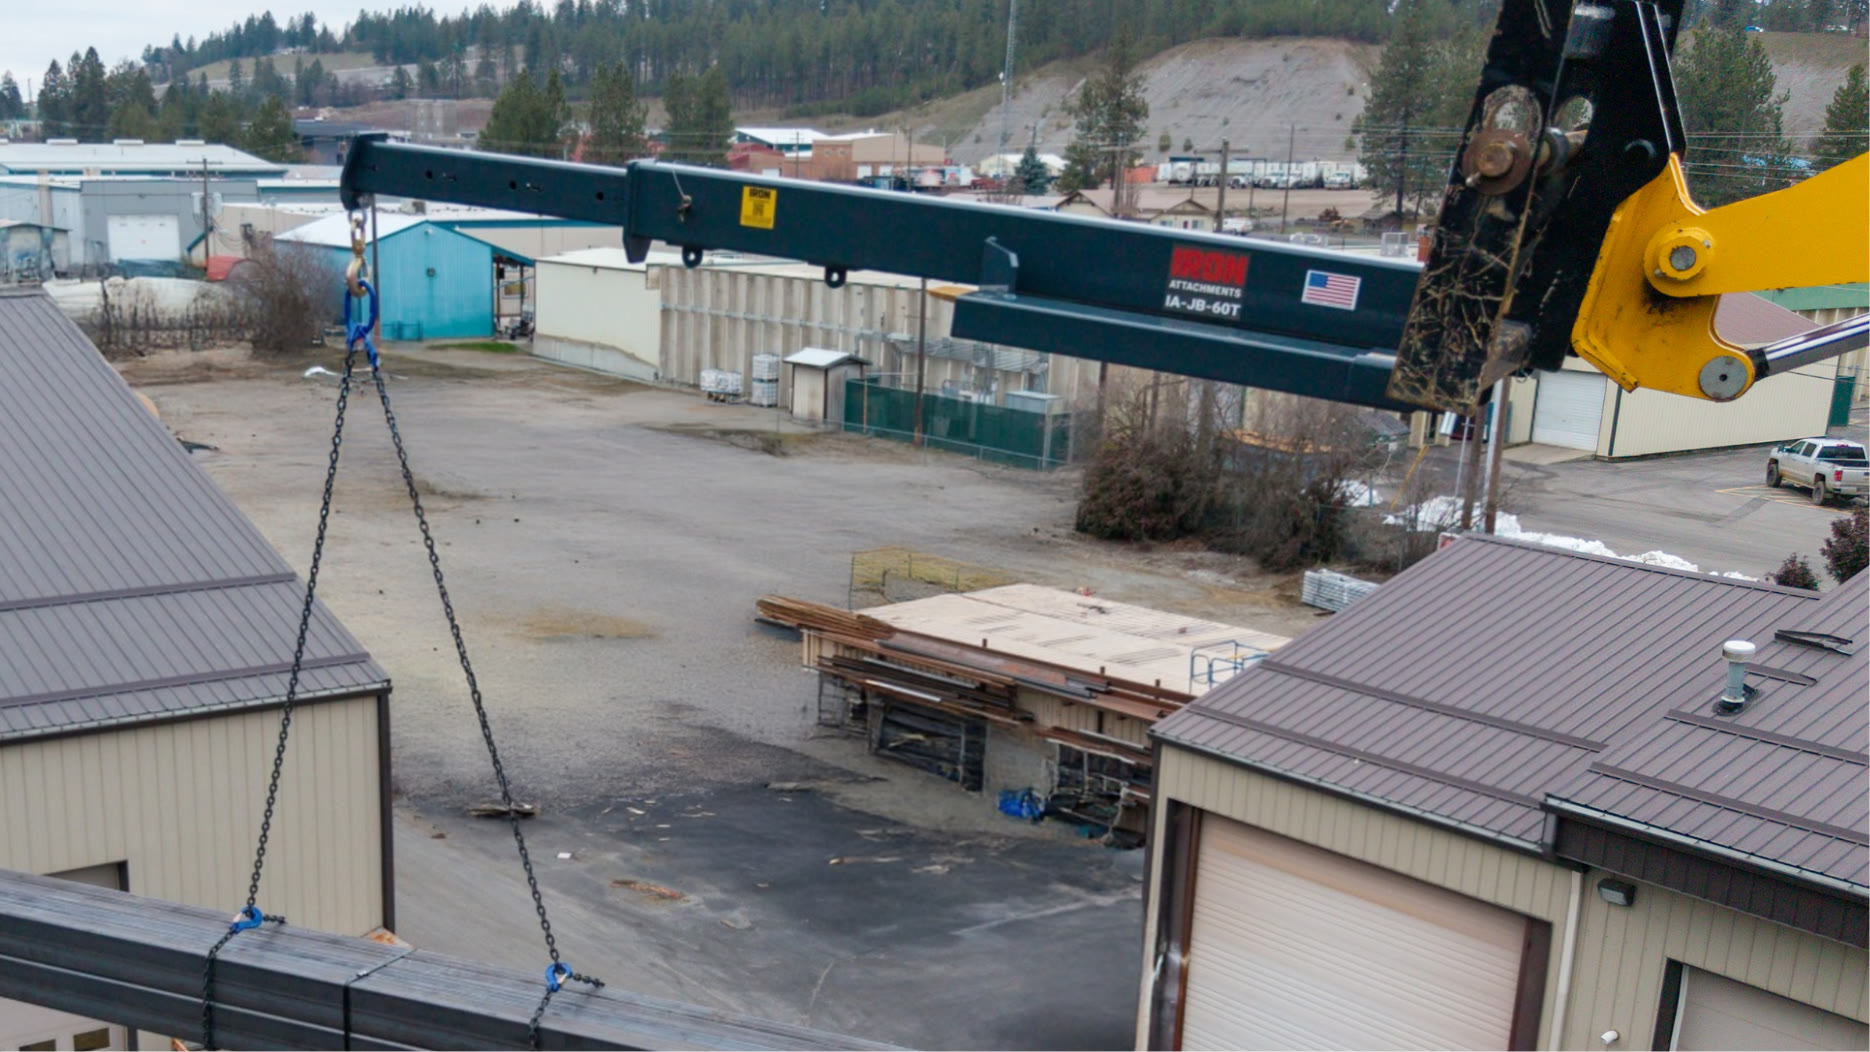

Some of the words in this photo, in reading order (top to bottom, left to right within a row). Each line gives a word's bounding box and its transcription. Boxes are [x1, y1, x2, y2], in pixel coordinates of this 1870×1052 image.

[1171, 247, 1248, 286] IRON
[1168, 279, 1242, 298] ATTACHMENTS
[1164, 294, 1242, 317] IA-JB-60T
